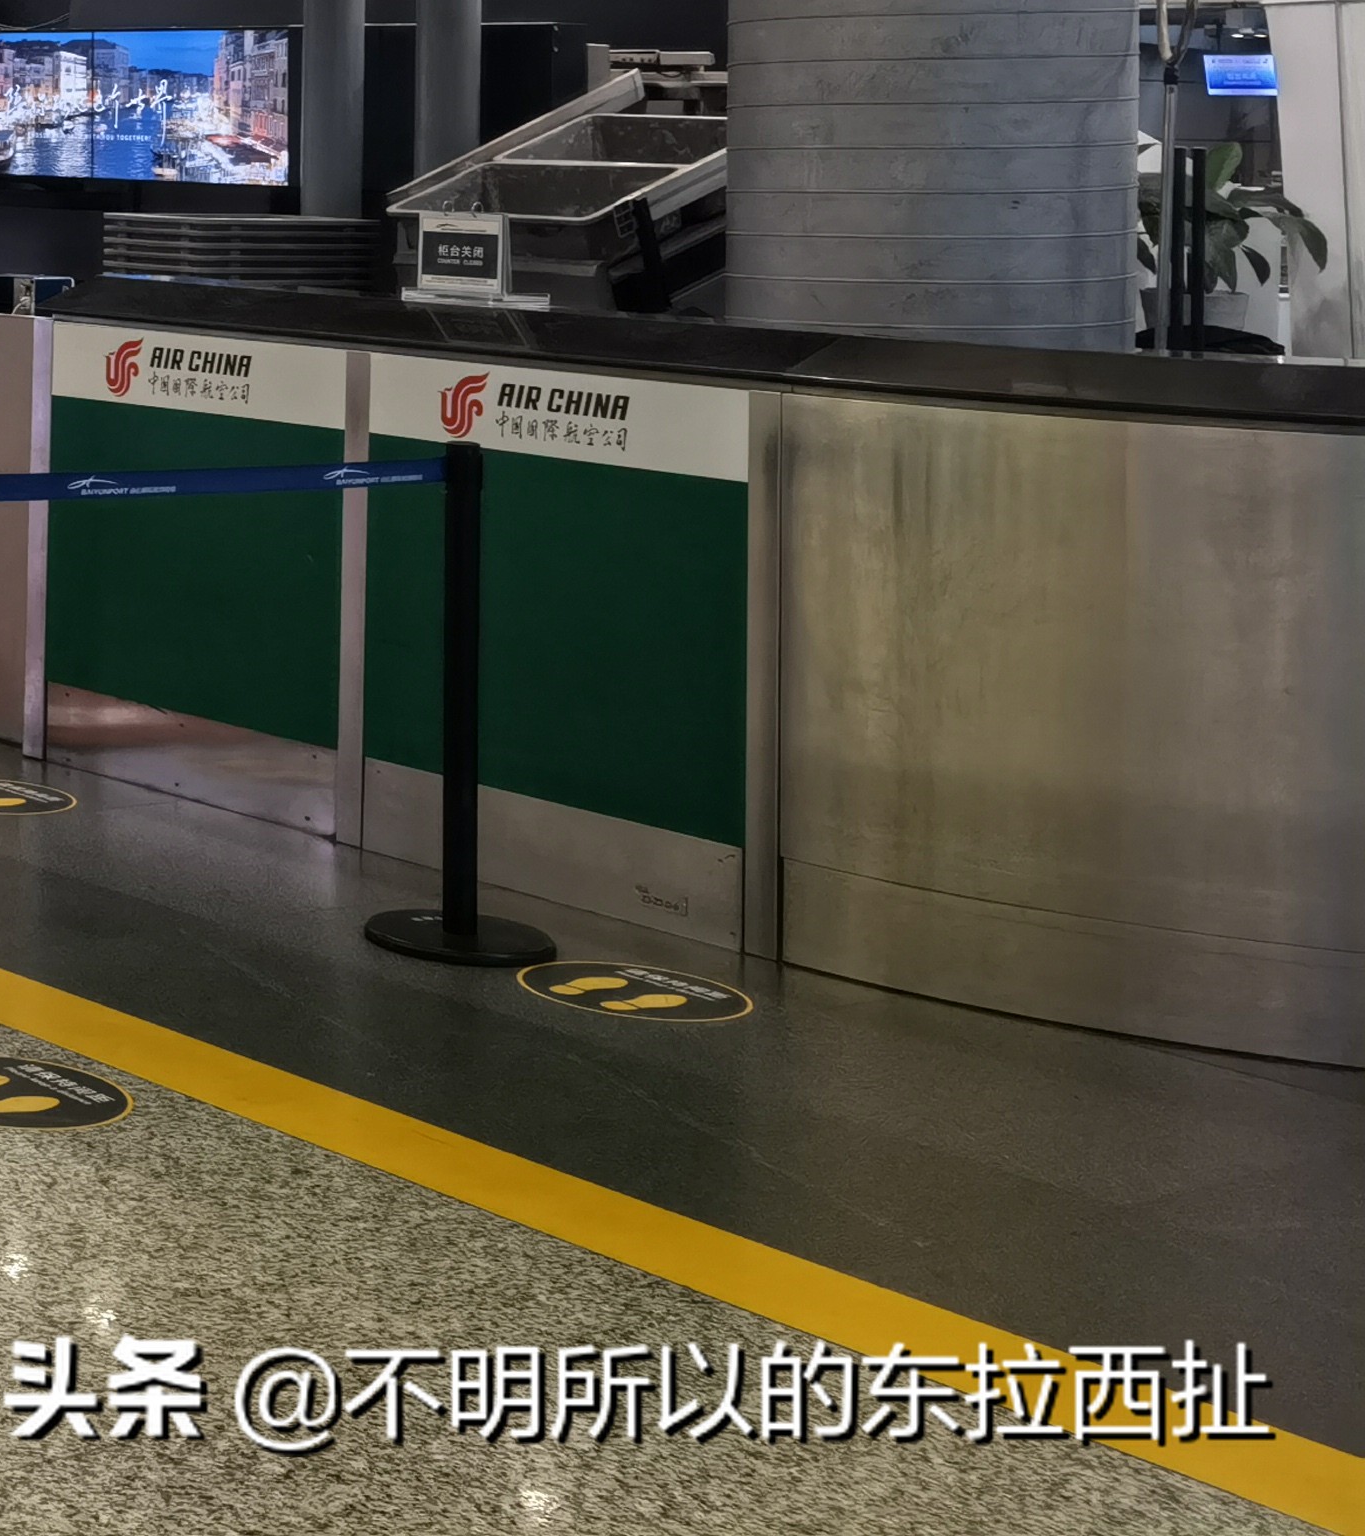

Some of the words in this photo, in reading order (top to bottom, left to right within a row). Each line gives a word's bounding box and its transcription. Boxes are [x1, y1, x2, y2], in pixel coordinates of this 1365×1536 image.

[437, 243, 484, 258] 柜台关闭
[149, 347, 184, 370] AIR
[188, 350, 252, 378] CHINA
[497, 383, 541, 411] AIR
[547, 388, 630, 421] CHINA
